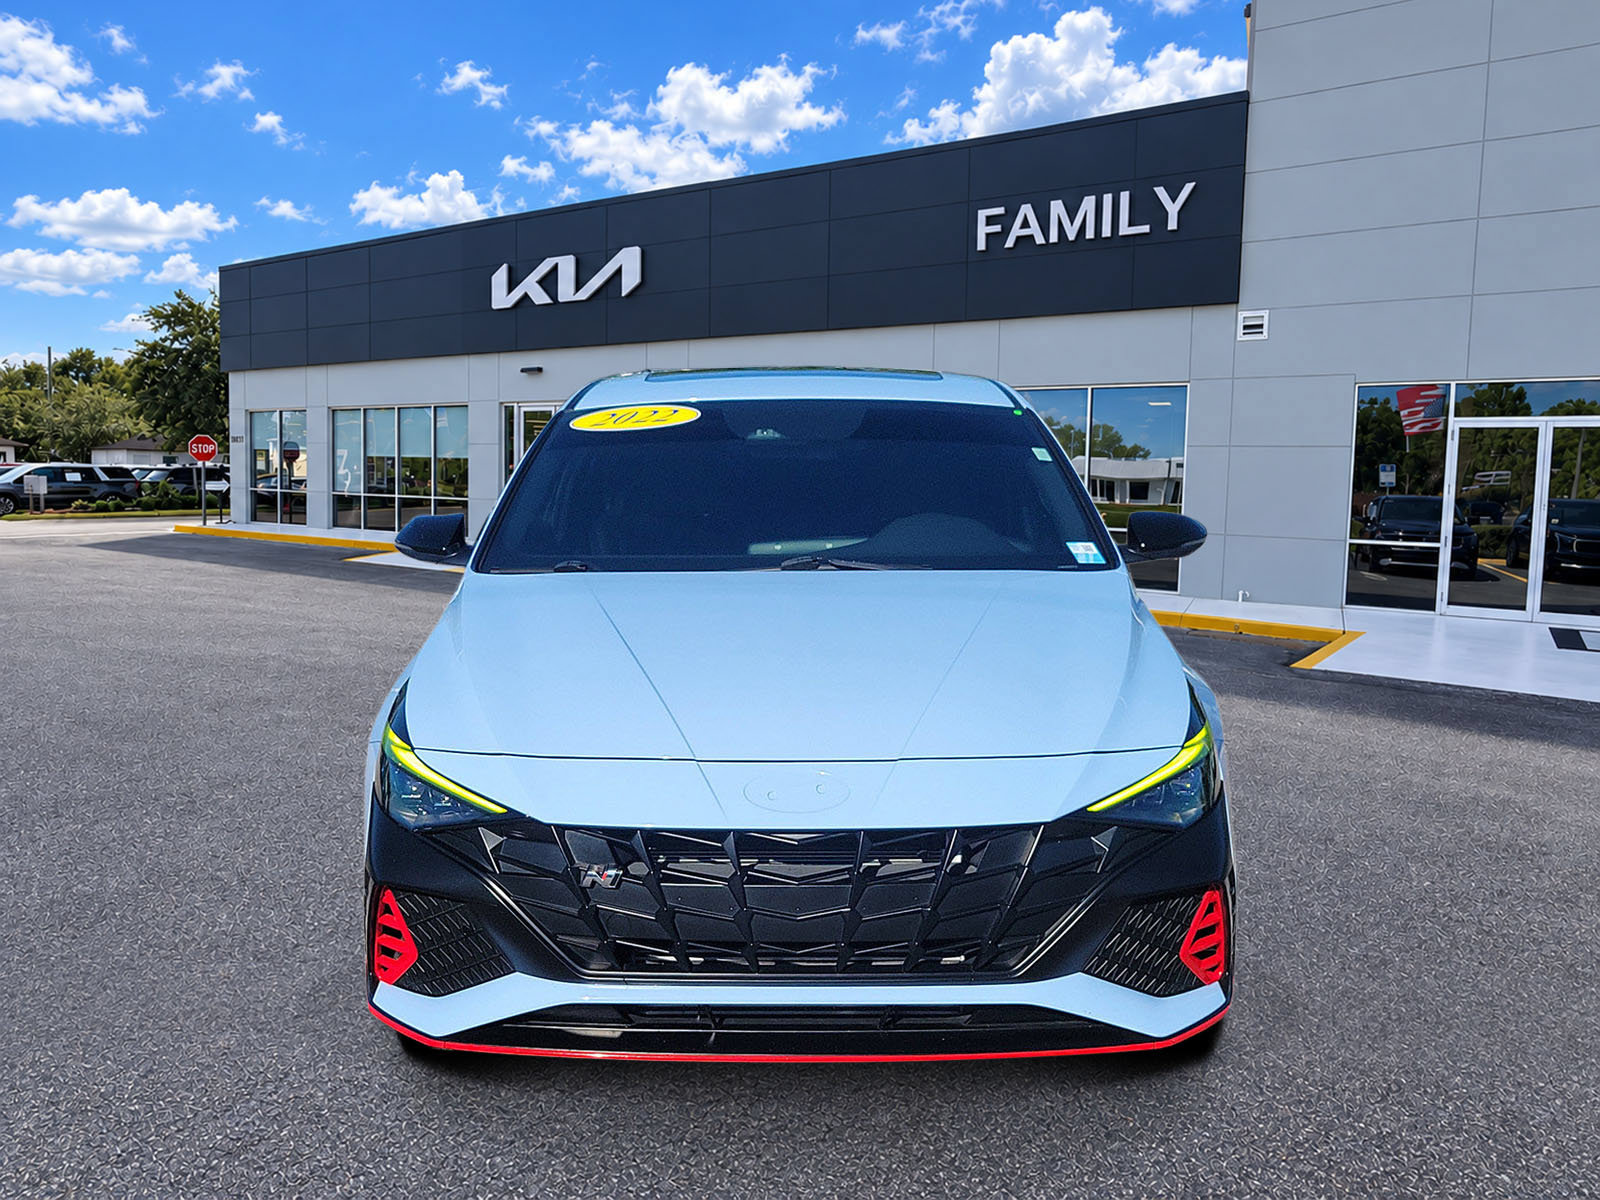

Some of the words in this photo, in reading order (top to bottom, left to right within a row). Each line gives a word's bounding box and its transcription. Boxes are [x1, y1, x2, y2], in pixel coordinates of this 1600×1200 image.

[976, 182, 1197, 251] FAMILY
[491, 245, 642, 310] KIA
[590, 409, 679, 427] 2022
[191, 443, 215, 454] STOP
